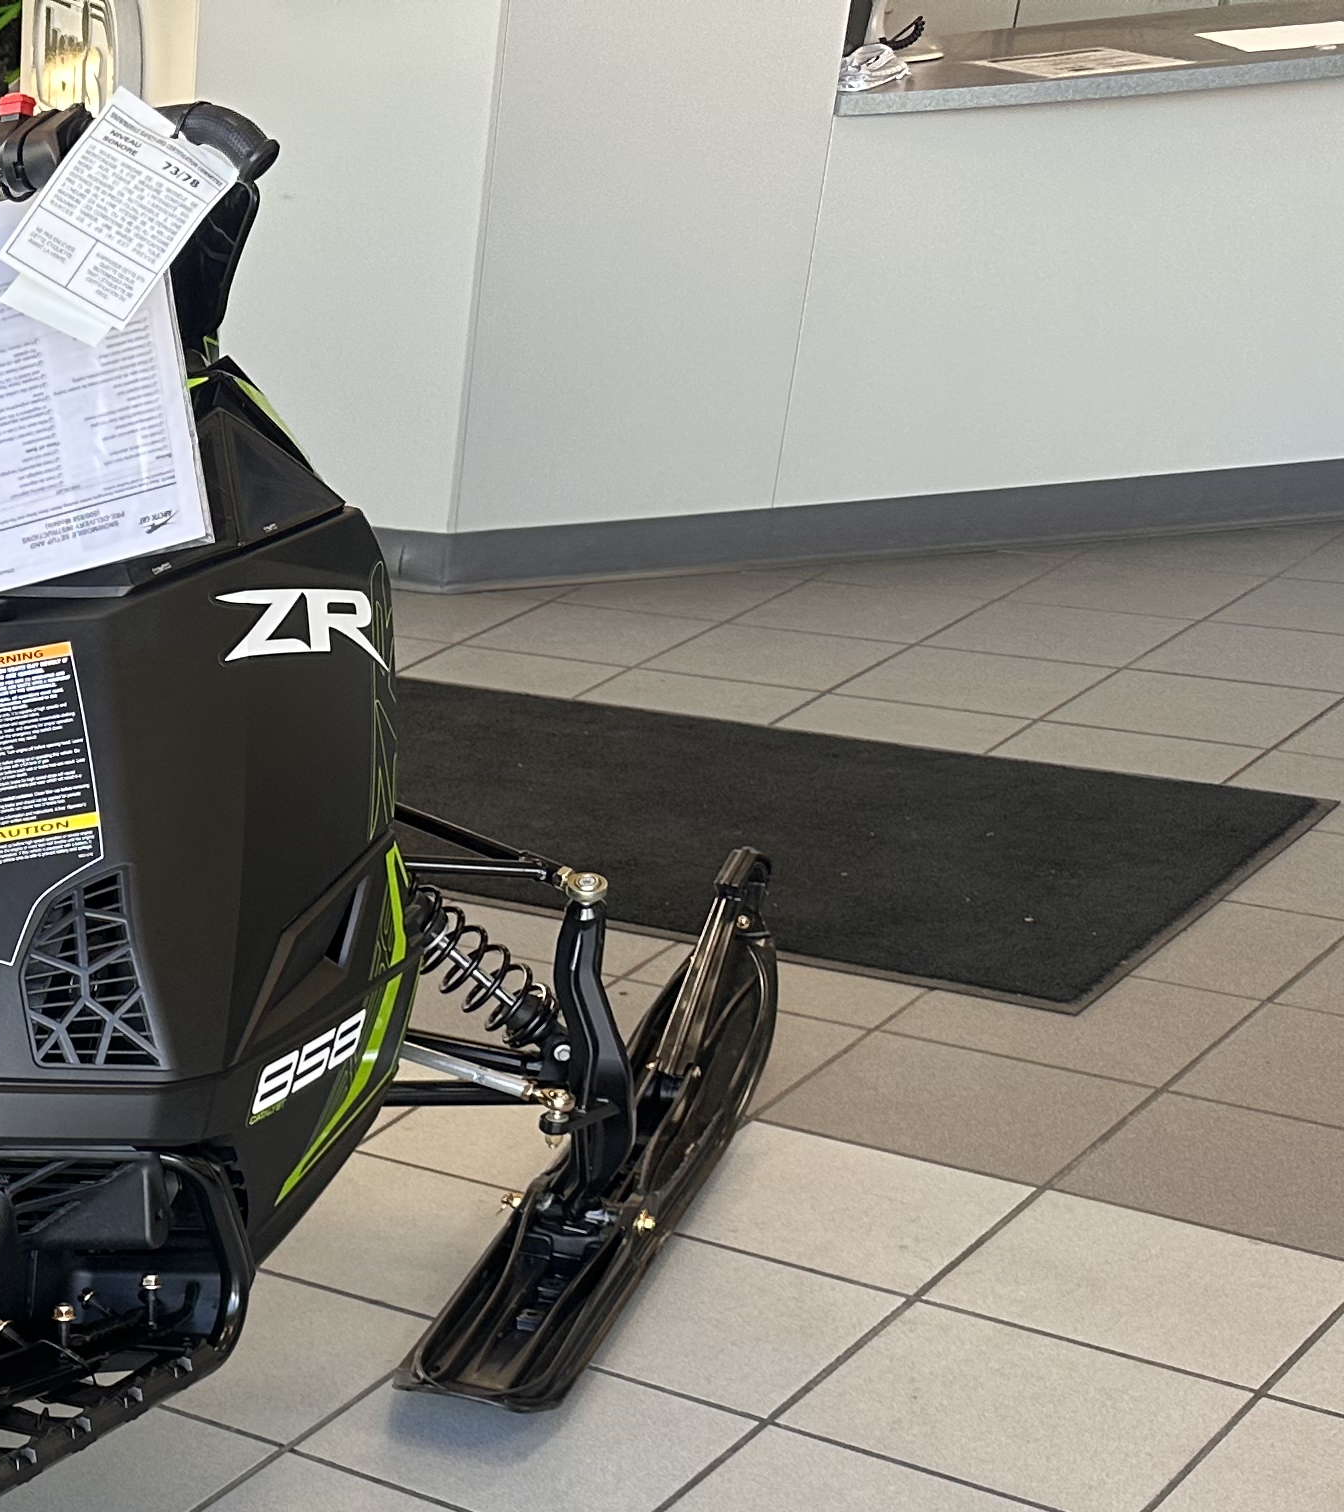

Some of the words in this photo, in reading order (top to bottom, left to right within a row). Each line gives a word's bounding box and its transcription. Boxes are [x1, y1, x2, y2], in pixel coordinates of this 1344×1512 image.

[102, 132, 138, 158] SONORE
[109, 126, 142, 151] NIVEAU
[160, 160, 200, 189] 73/78
[137, 515, 150, 525] CAT
[29, 540, 45, 549] AND
[215, 588, 389, 671] ZR
[252, 1008, 366, 1115] 858
